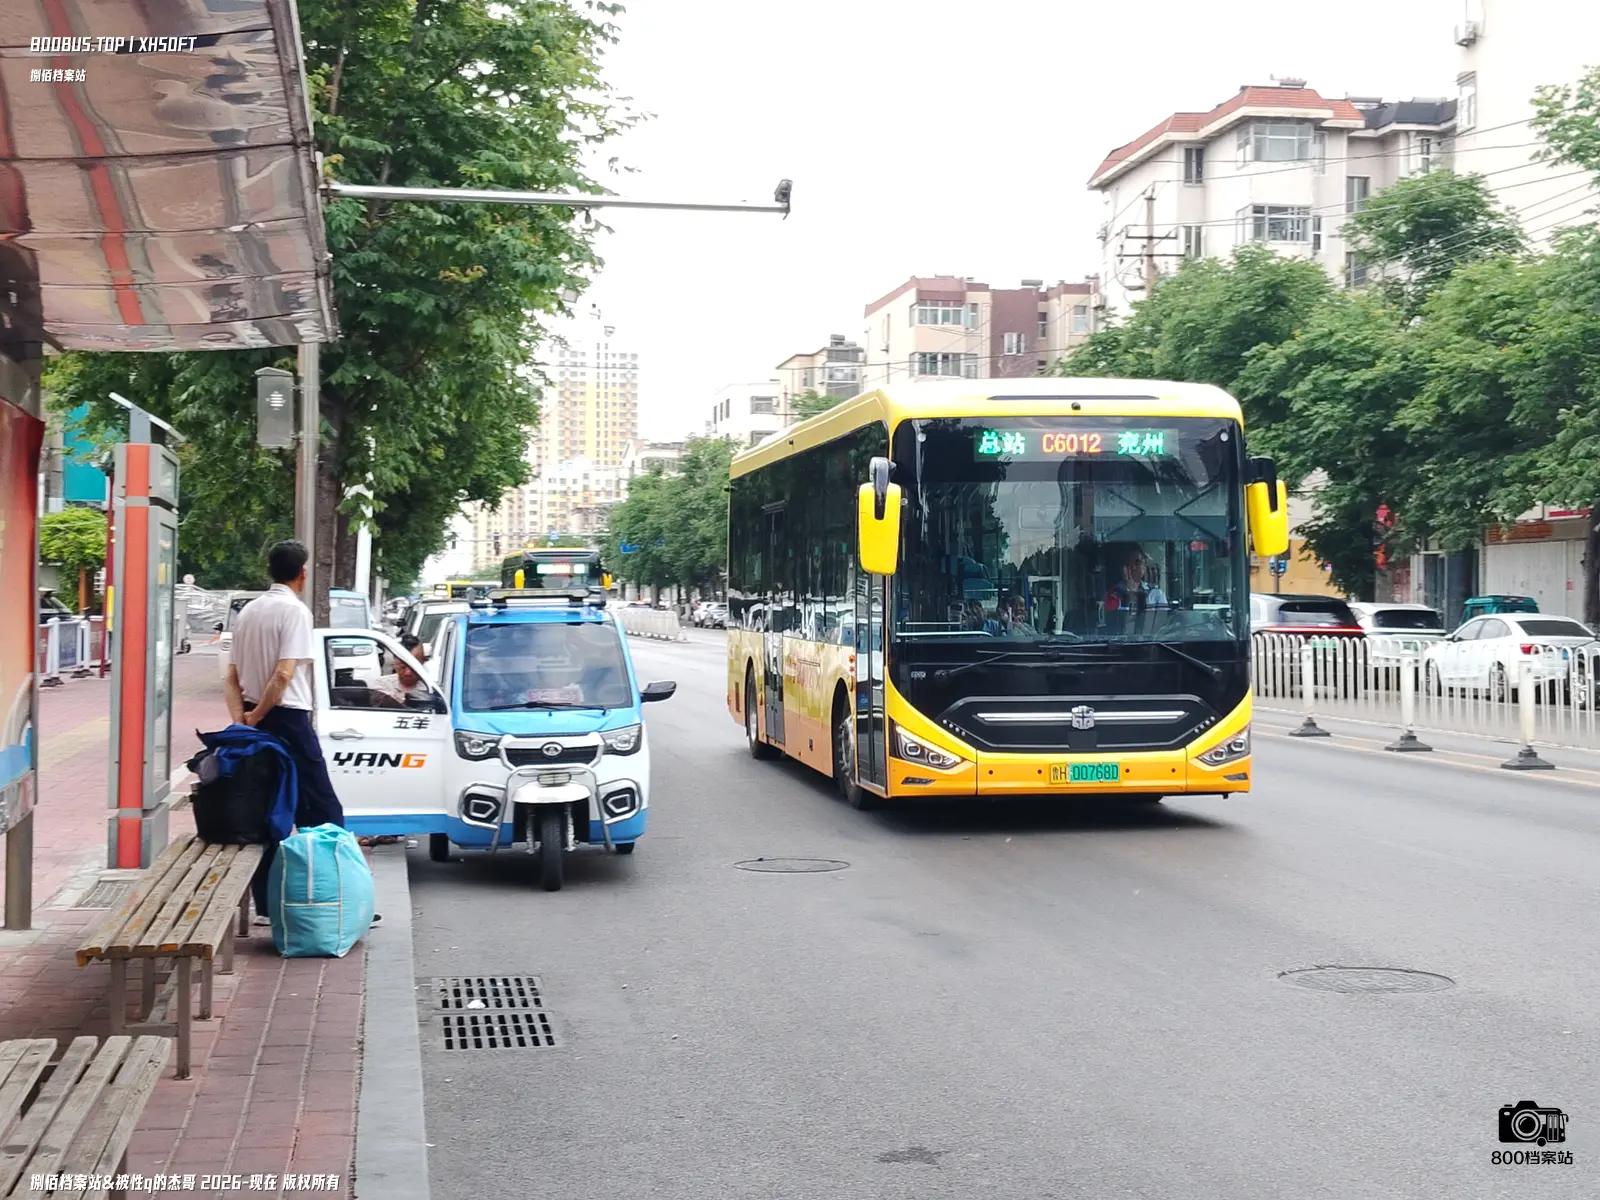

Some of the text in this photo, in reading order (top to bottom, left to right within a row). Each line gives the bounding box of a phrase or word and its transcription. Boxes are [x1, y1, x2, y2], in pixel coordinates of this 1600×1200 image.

[978, 431, 1026, 455] 总站
[1041, 433, 1102, 454] C6012
[393, 716, 430, 730] 五羊
[333, 752, 428, 769] YANG
